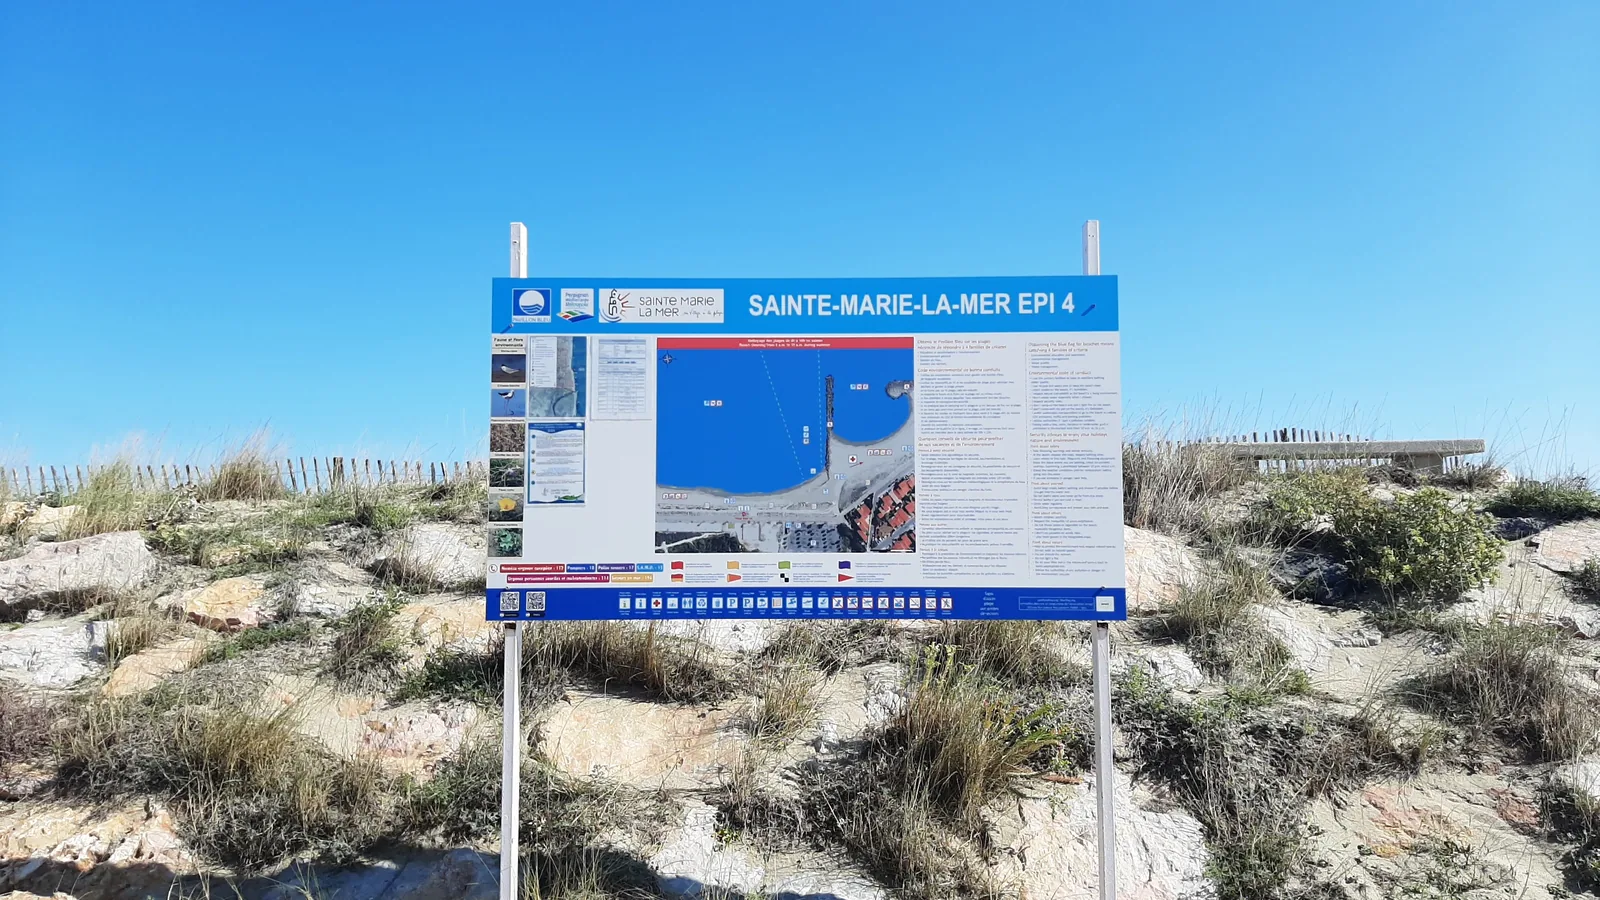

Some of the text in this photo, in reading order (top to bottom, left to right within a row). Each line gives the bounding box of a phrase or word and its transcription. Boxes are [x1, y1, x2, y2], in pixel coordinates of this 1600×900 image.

[749, 292, 1075, 316] SAINTE-MARIE-LA-MER EPI 4
